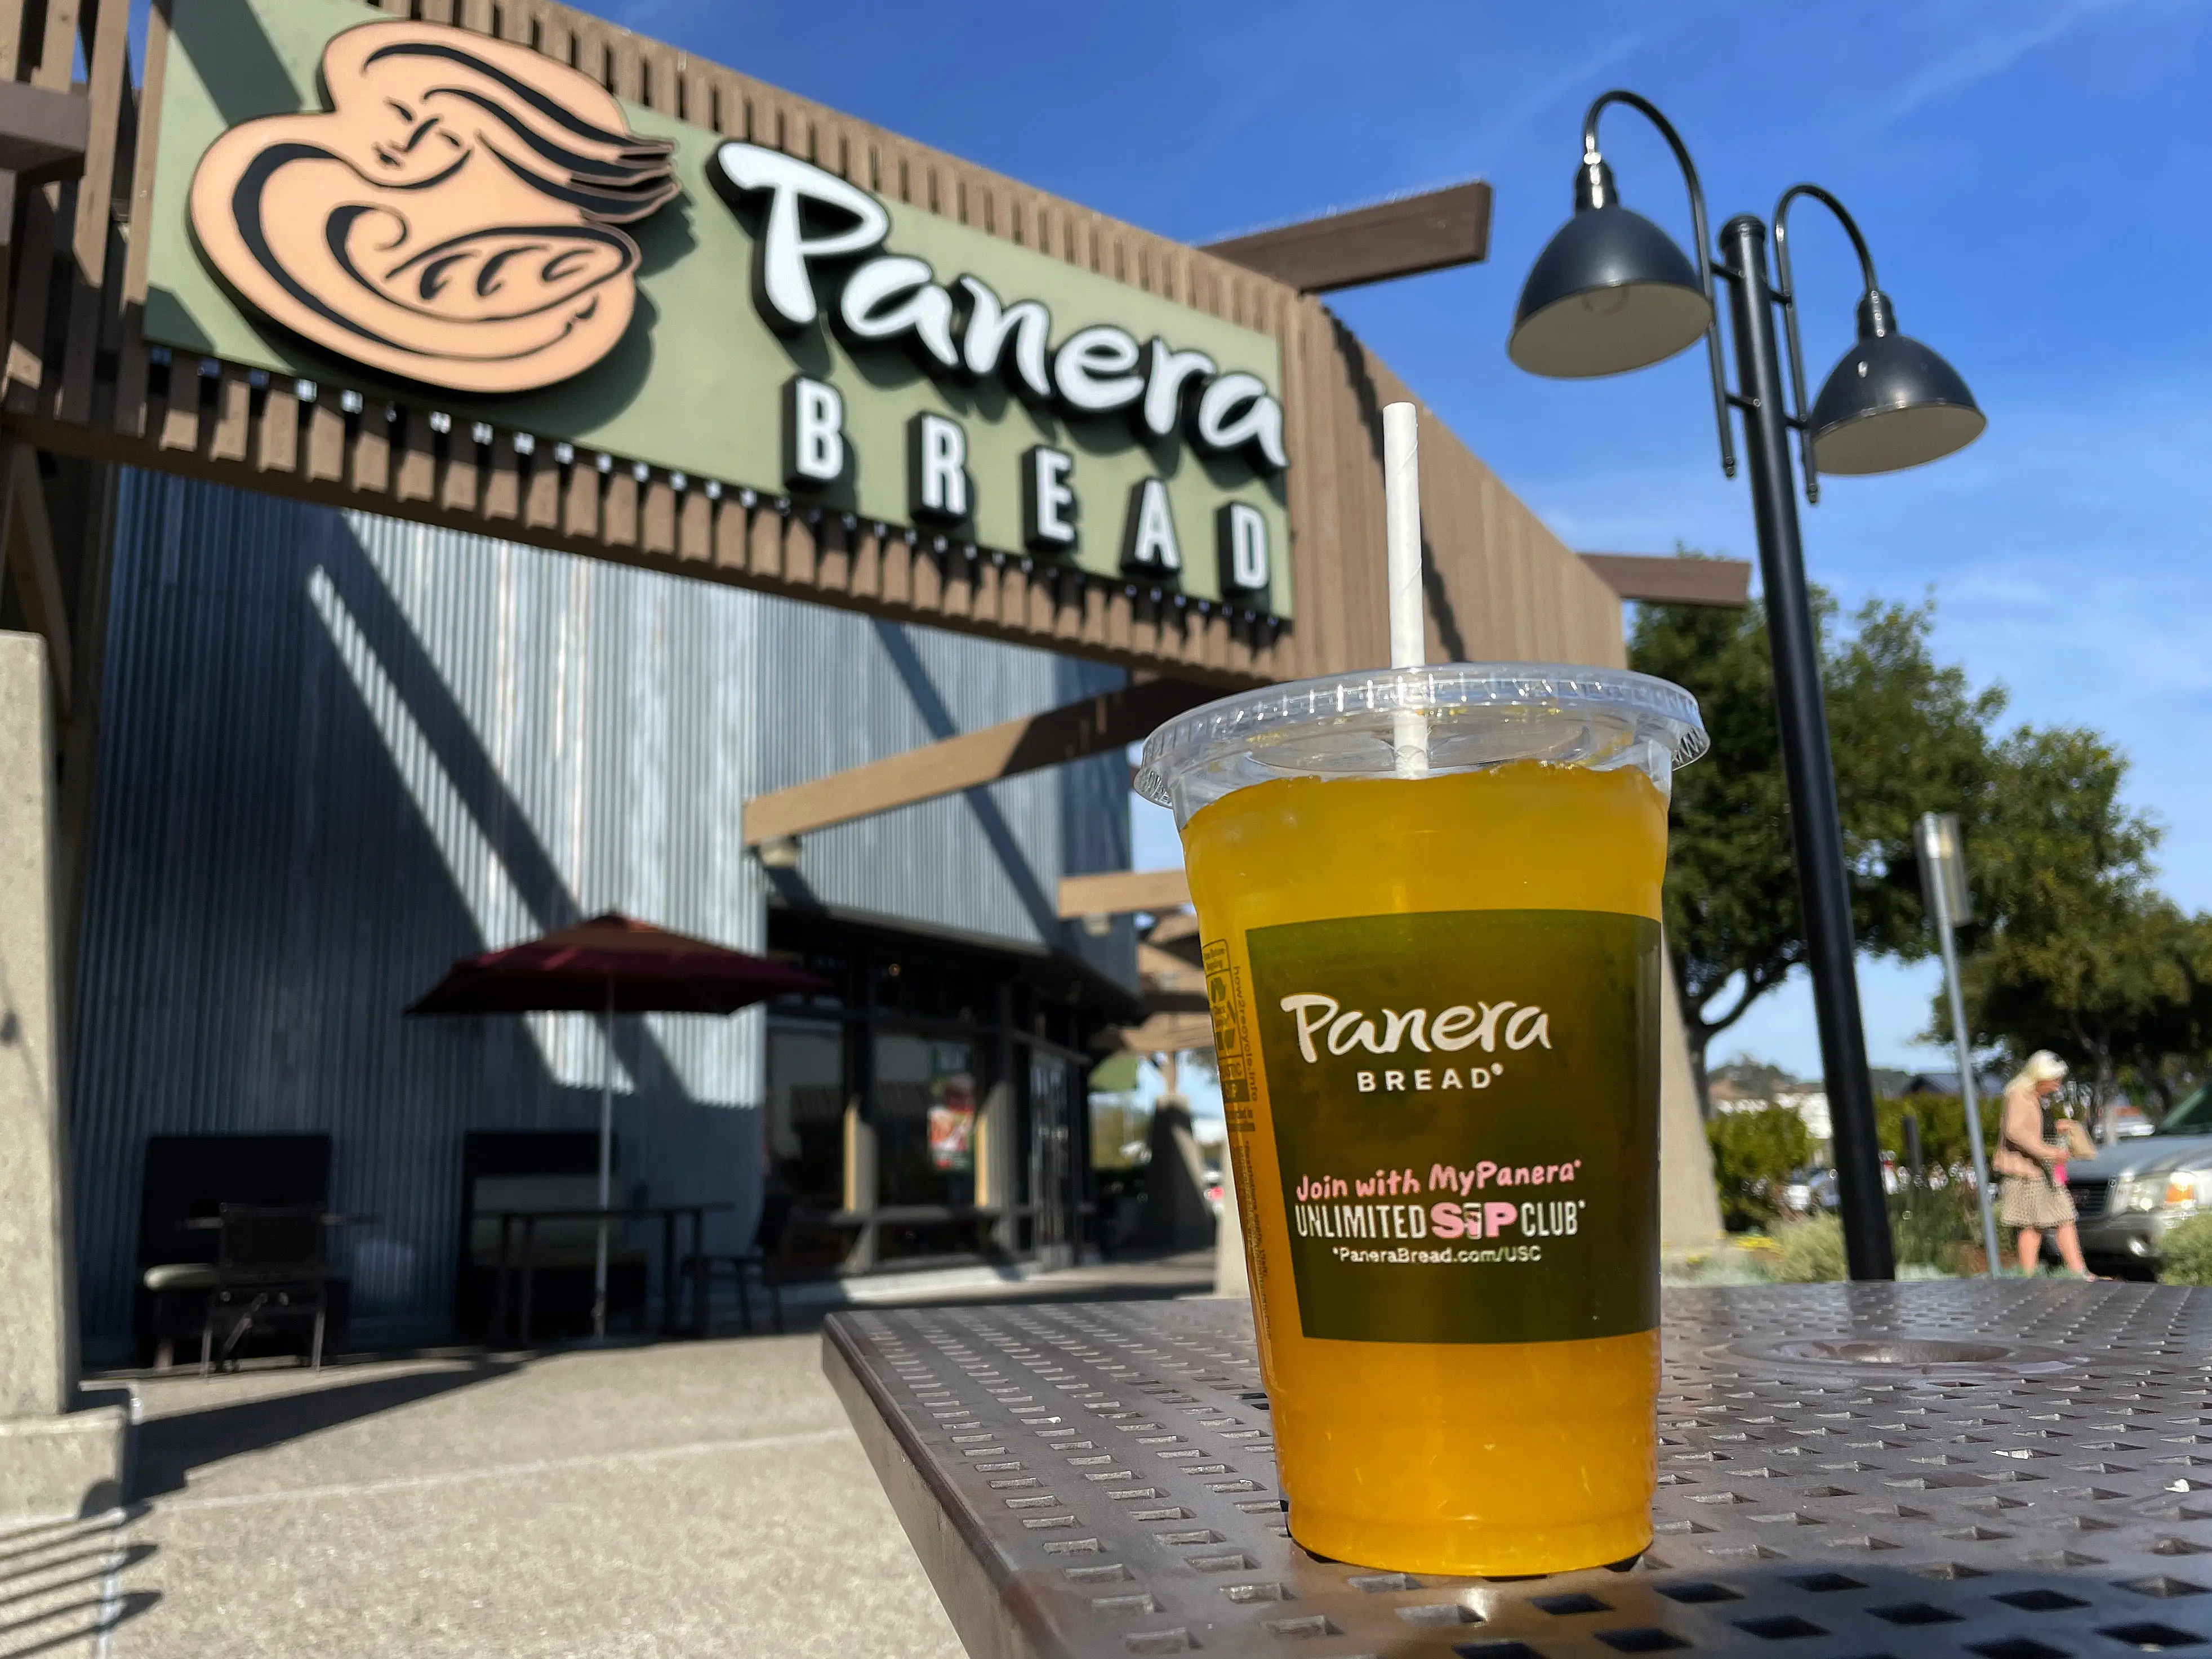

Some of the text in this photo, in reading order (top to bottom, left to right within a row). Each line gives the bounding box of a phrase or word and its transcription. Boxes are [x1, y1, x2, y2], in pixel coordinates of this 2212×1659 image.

[717, 141, 1289, 468] Panera
[795, 376, 1269, 590] BREAD
[1280, 993, 1552, 1064] Panera
[1296, 1175, 1348, 1202] Join
[1355, 1168, 1420, 1197] with
[1295, 1204, 1427, 1239] UNLIMITED
